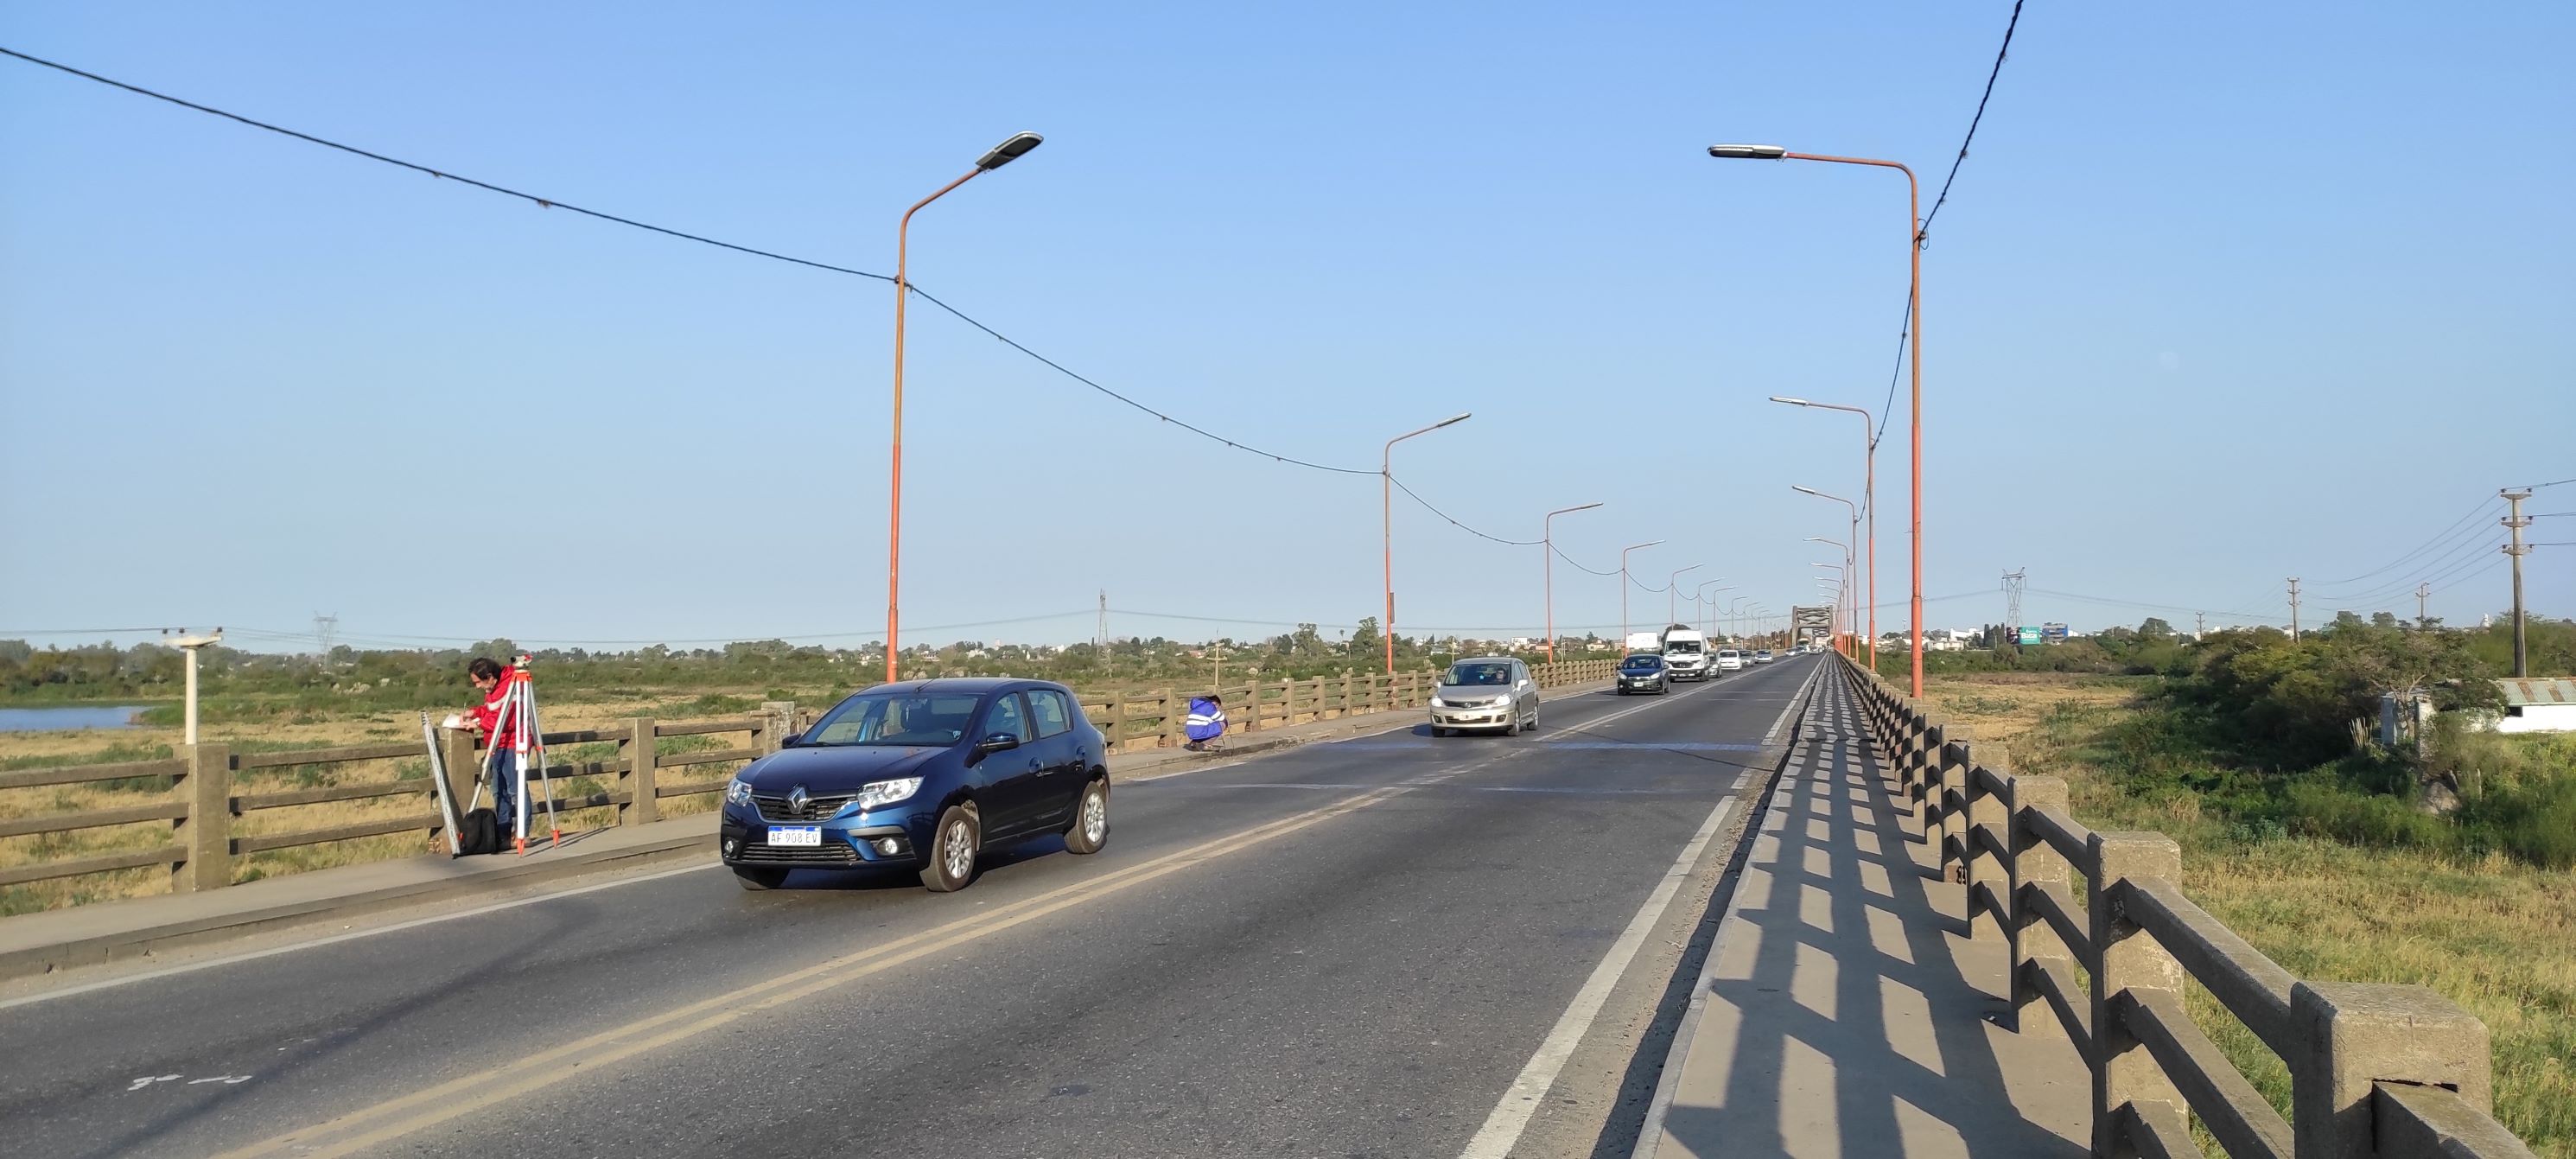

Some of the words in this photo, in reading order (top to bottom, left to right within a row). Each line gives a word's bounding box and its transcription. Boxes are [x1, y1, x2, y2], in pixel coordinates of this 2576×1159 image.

[771, 832, 782, 844] AF
[786, 832, 803, 844] 908
[805, 832, 817, 844] EV
